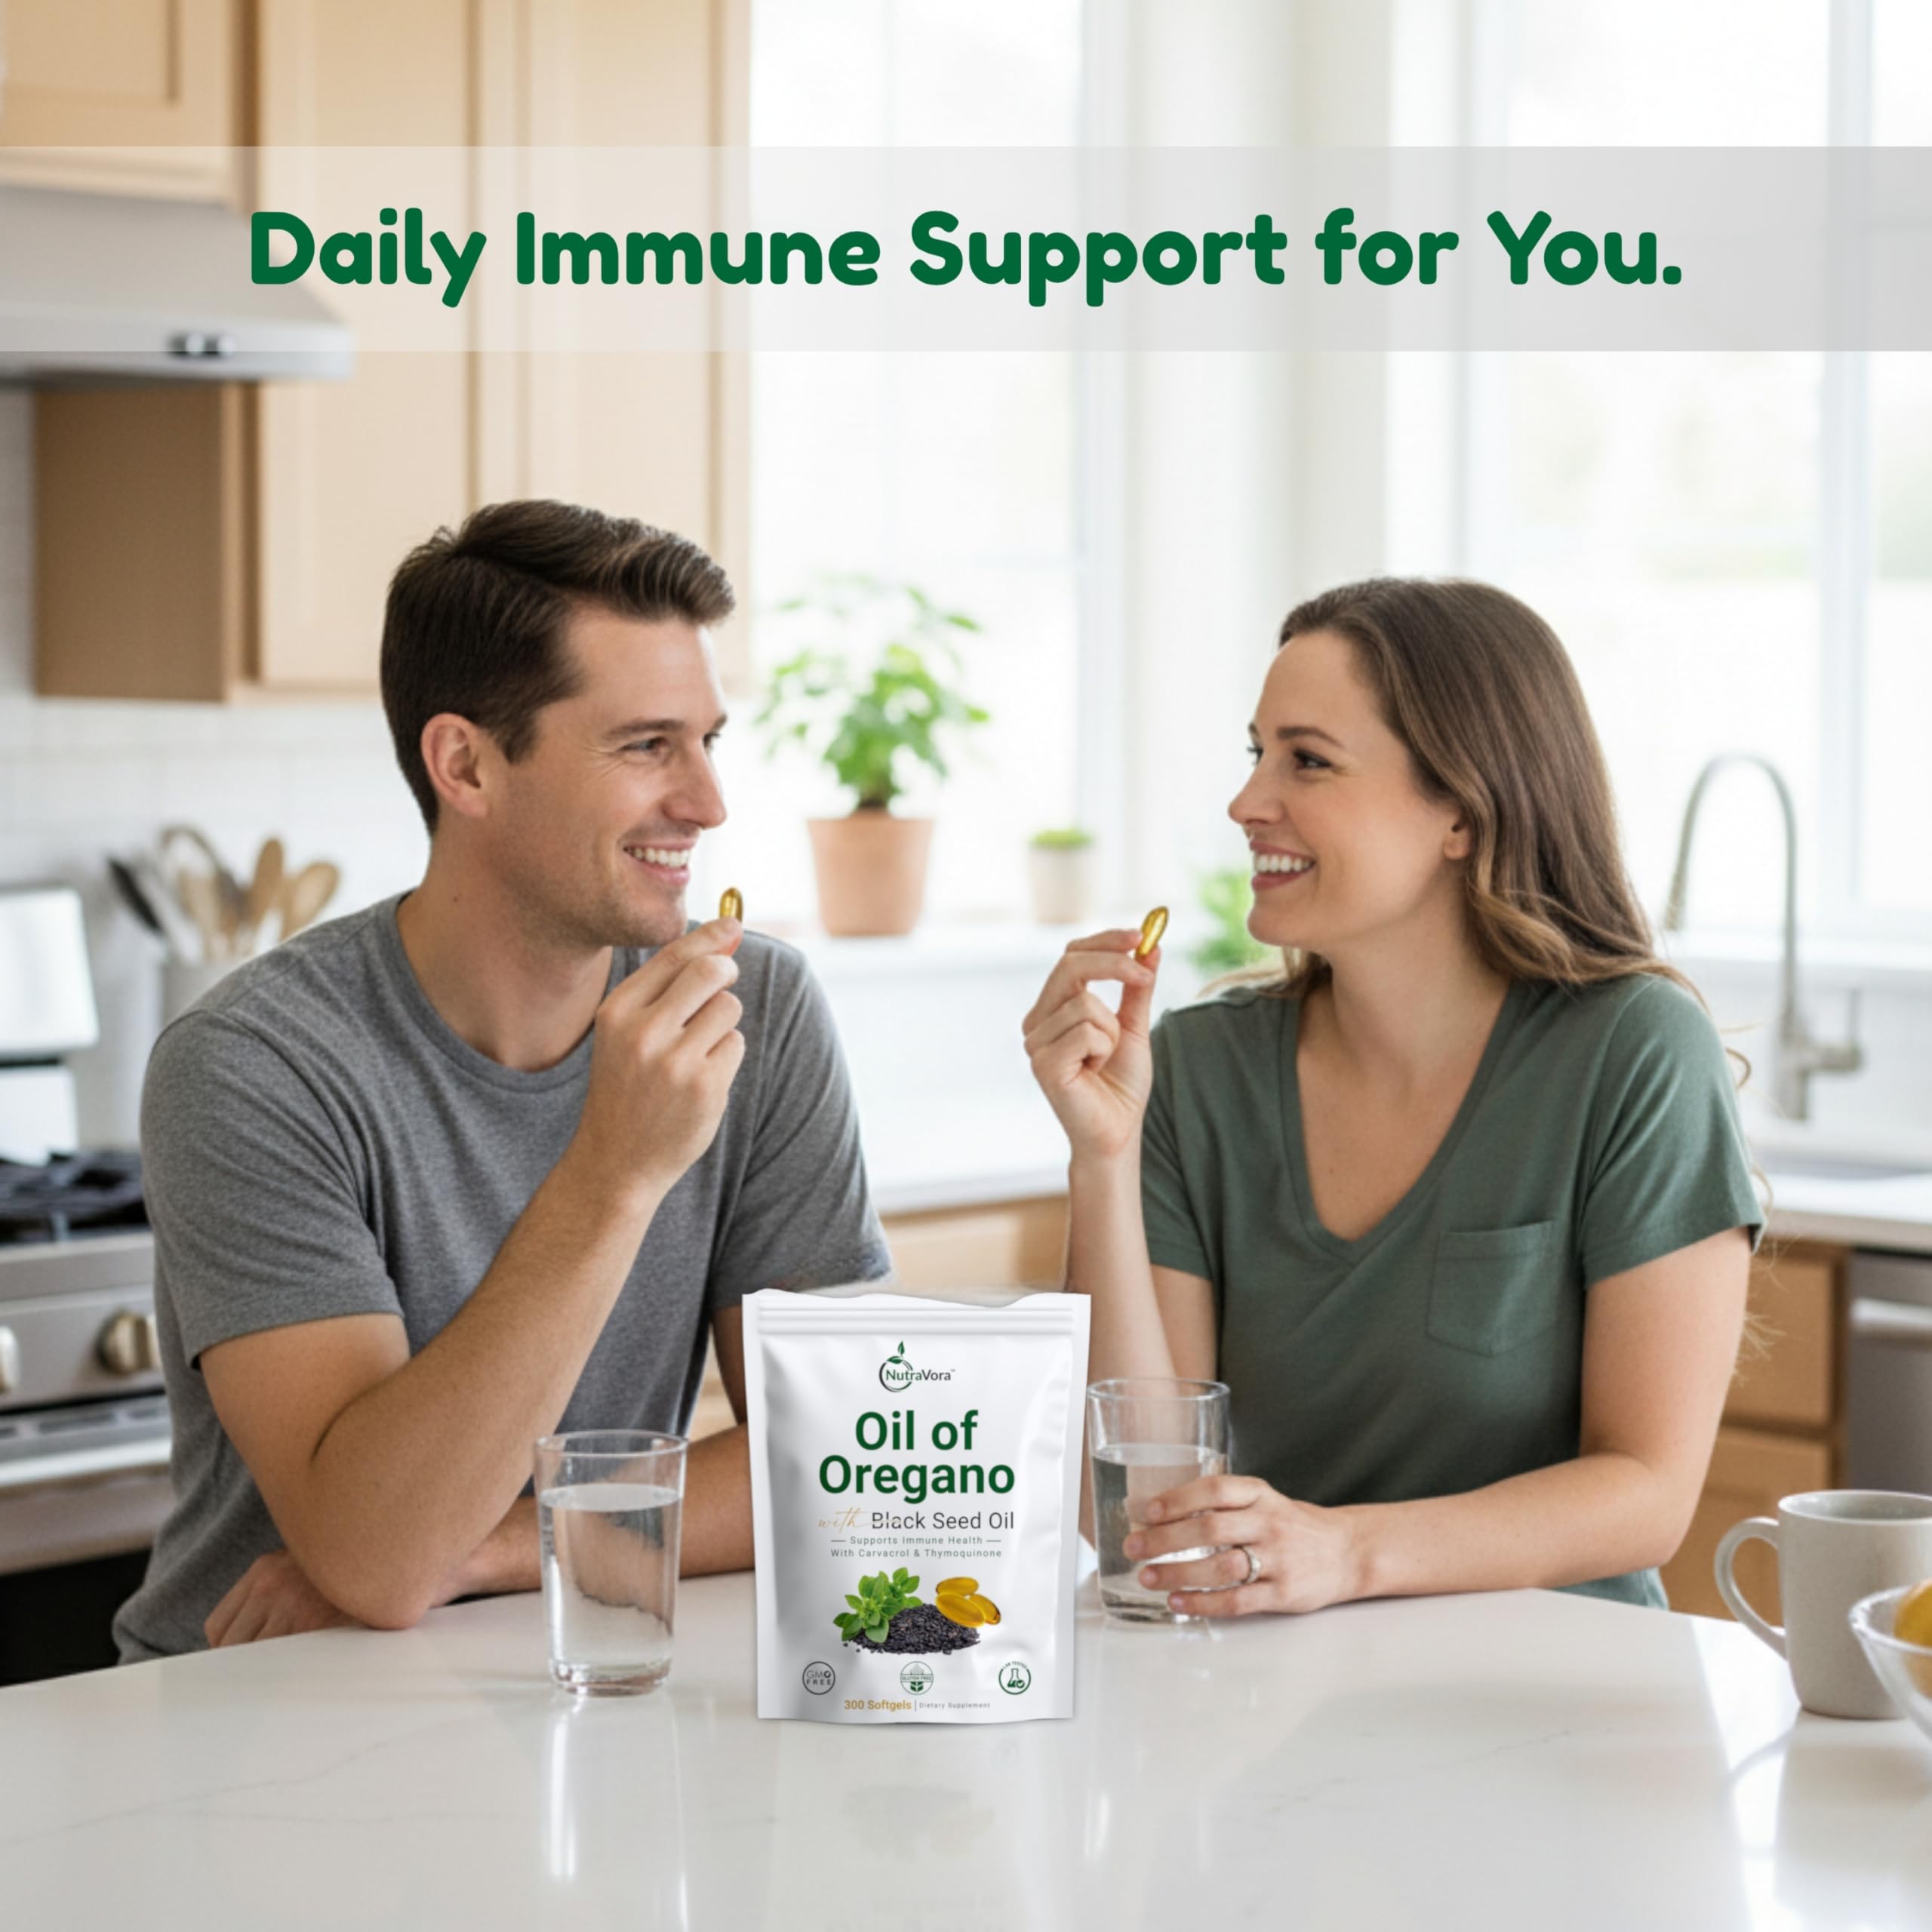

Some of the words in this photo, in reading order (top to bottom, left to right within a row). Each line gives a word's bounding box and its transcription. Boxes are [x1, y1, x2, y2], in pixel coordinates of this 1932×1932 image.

[856, 1410, 914, 1450] Oil
[932, 1410, 978, 1450] of
[820, 1455, 1015, 1504] Oregano
[818, 1507, 868, 1534] with
[872, 1512, 926, 1529] Black
[933, 1512, 981, 1529] Seed
[989, 1512, 1014, 1529] Oil
[850, 1536, 897, 1546] Supports
[903, 1536, 943, 1544] Immune
[948, 1536, 983, 1544] Health
[831, 1549, 854, 1557] With
[858, 1549, 909, 1557] Carvacrol
[913, 1549, 920, 1557] &
[924, 1549, 1002, 1558] Thymoquinone
[844, 1700, 864, 1710] 300
[868, 1700, 912, 1712] Softgels
